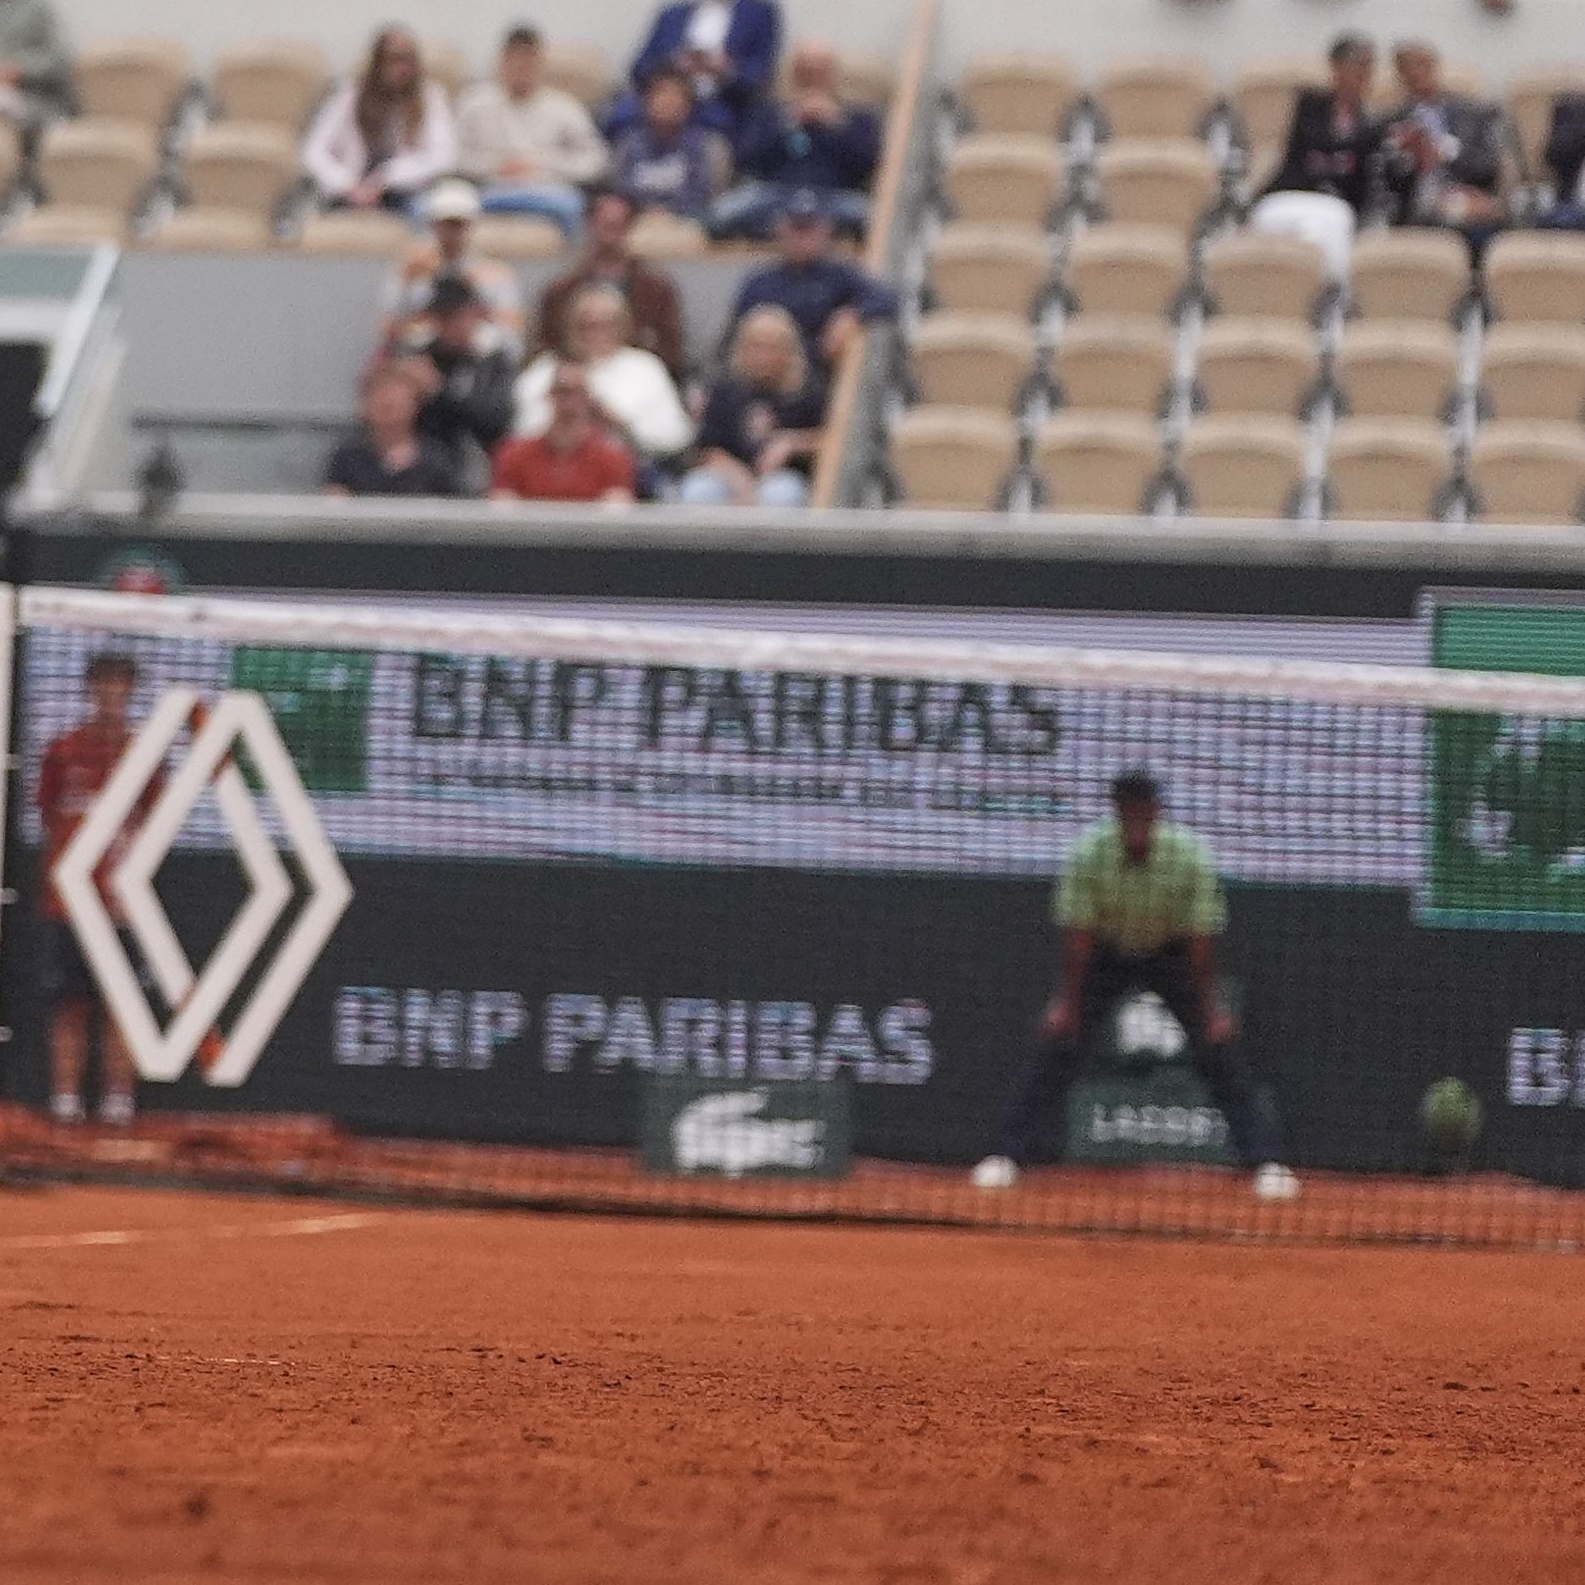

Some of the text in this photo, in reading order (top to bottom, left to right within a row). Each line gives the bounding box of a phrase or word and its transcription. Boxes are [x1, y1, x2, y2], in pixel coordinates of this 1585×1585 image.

[412, 650, 1063, 758] BNP PARIBAS
[332, 985, 934, 1086] BNP PARIBAS
